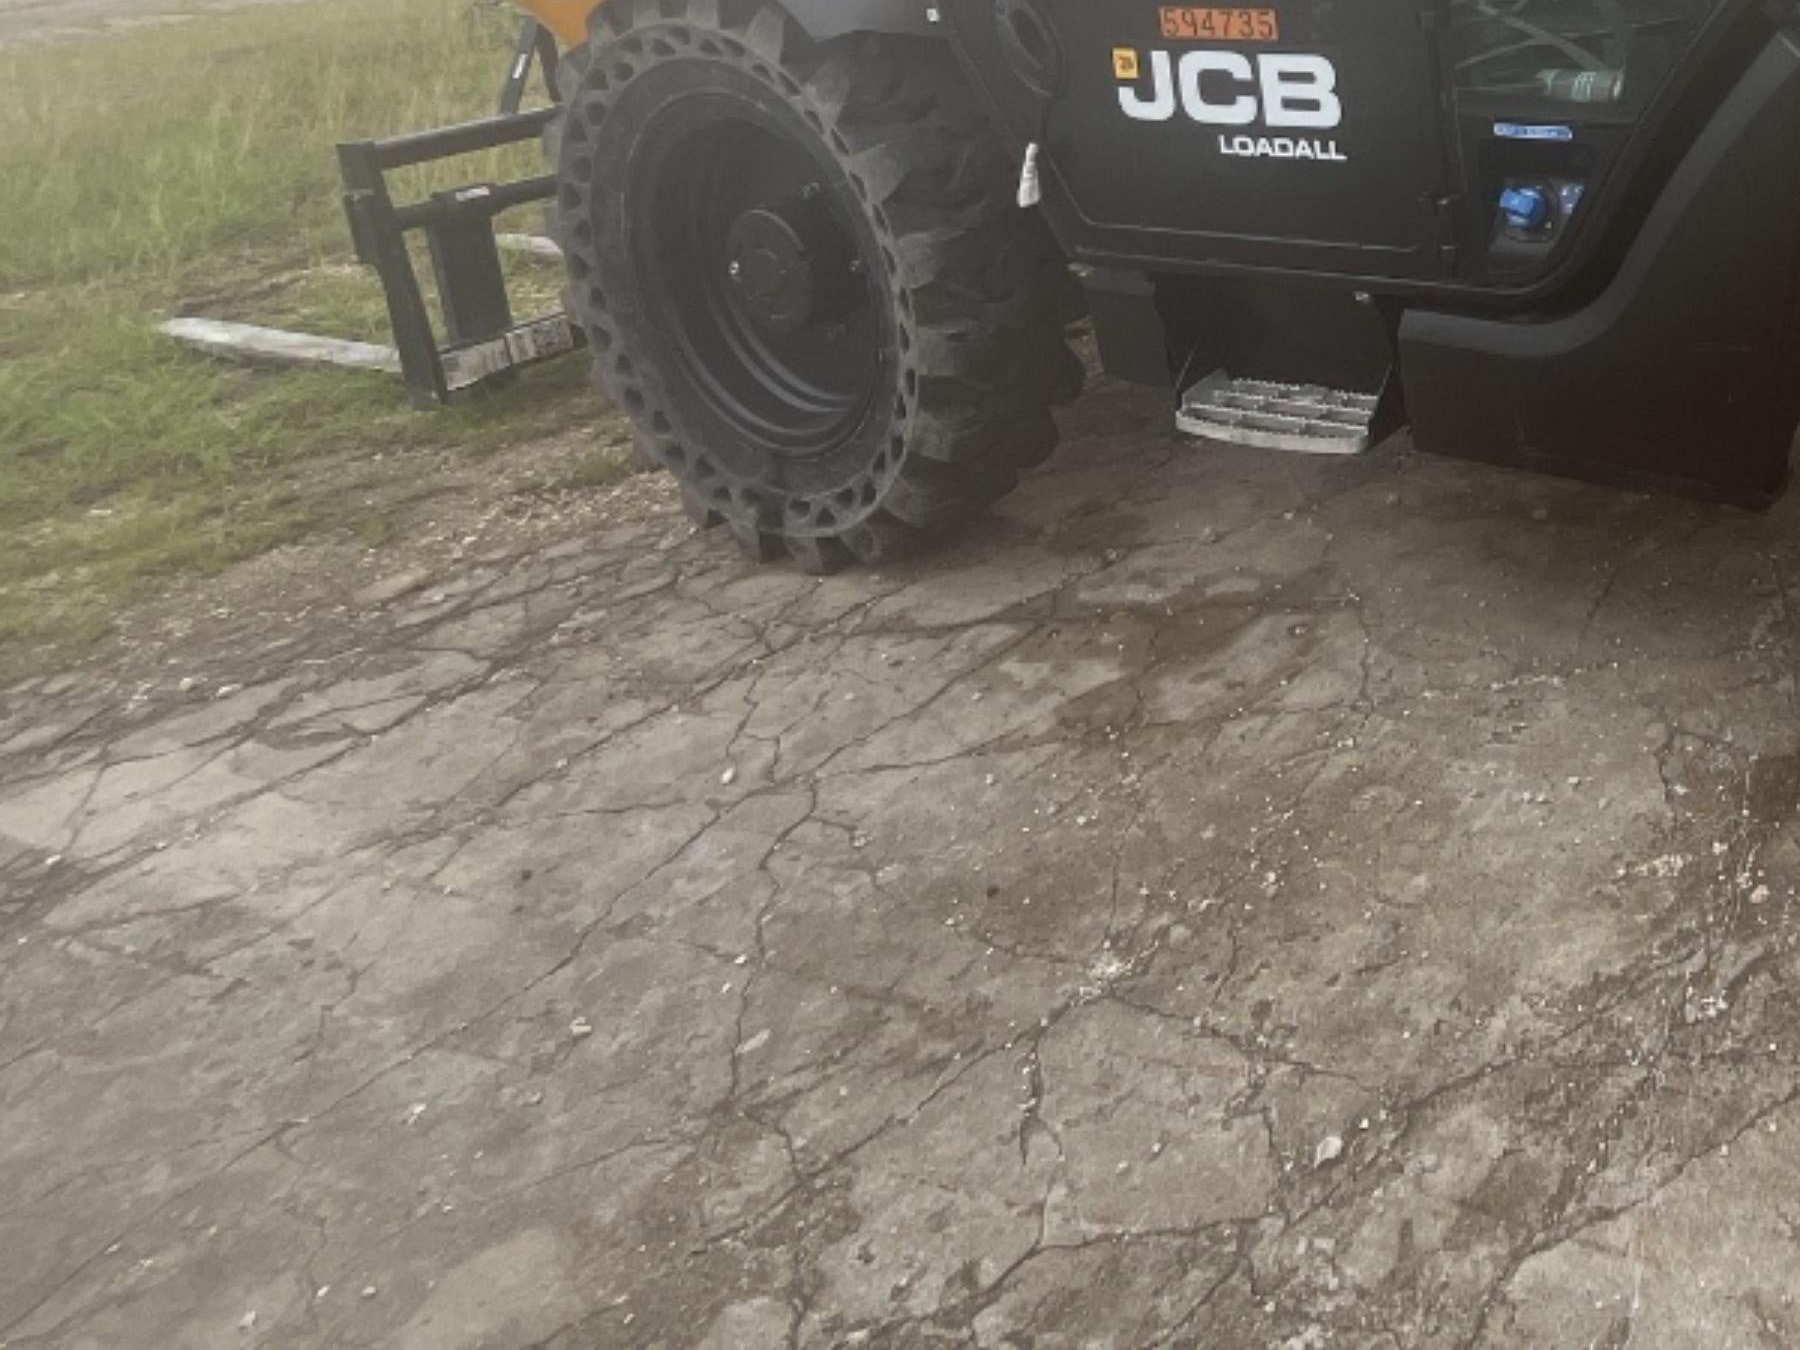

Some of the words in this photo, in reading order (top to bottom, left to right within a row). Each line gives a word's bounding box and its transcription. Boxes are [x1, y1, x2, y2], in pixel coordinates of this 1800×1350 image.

[1163, 8, 1274, 38] 594735
[1116, 50, 1342, 128] JCB
[1218, 134, 1347, 160] LOADALL
